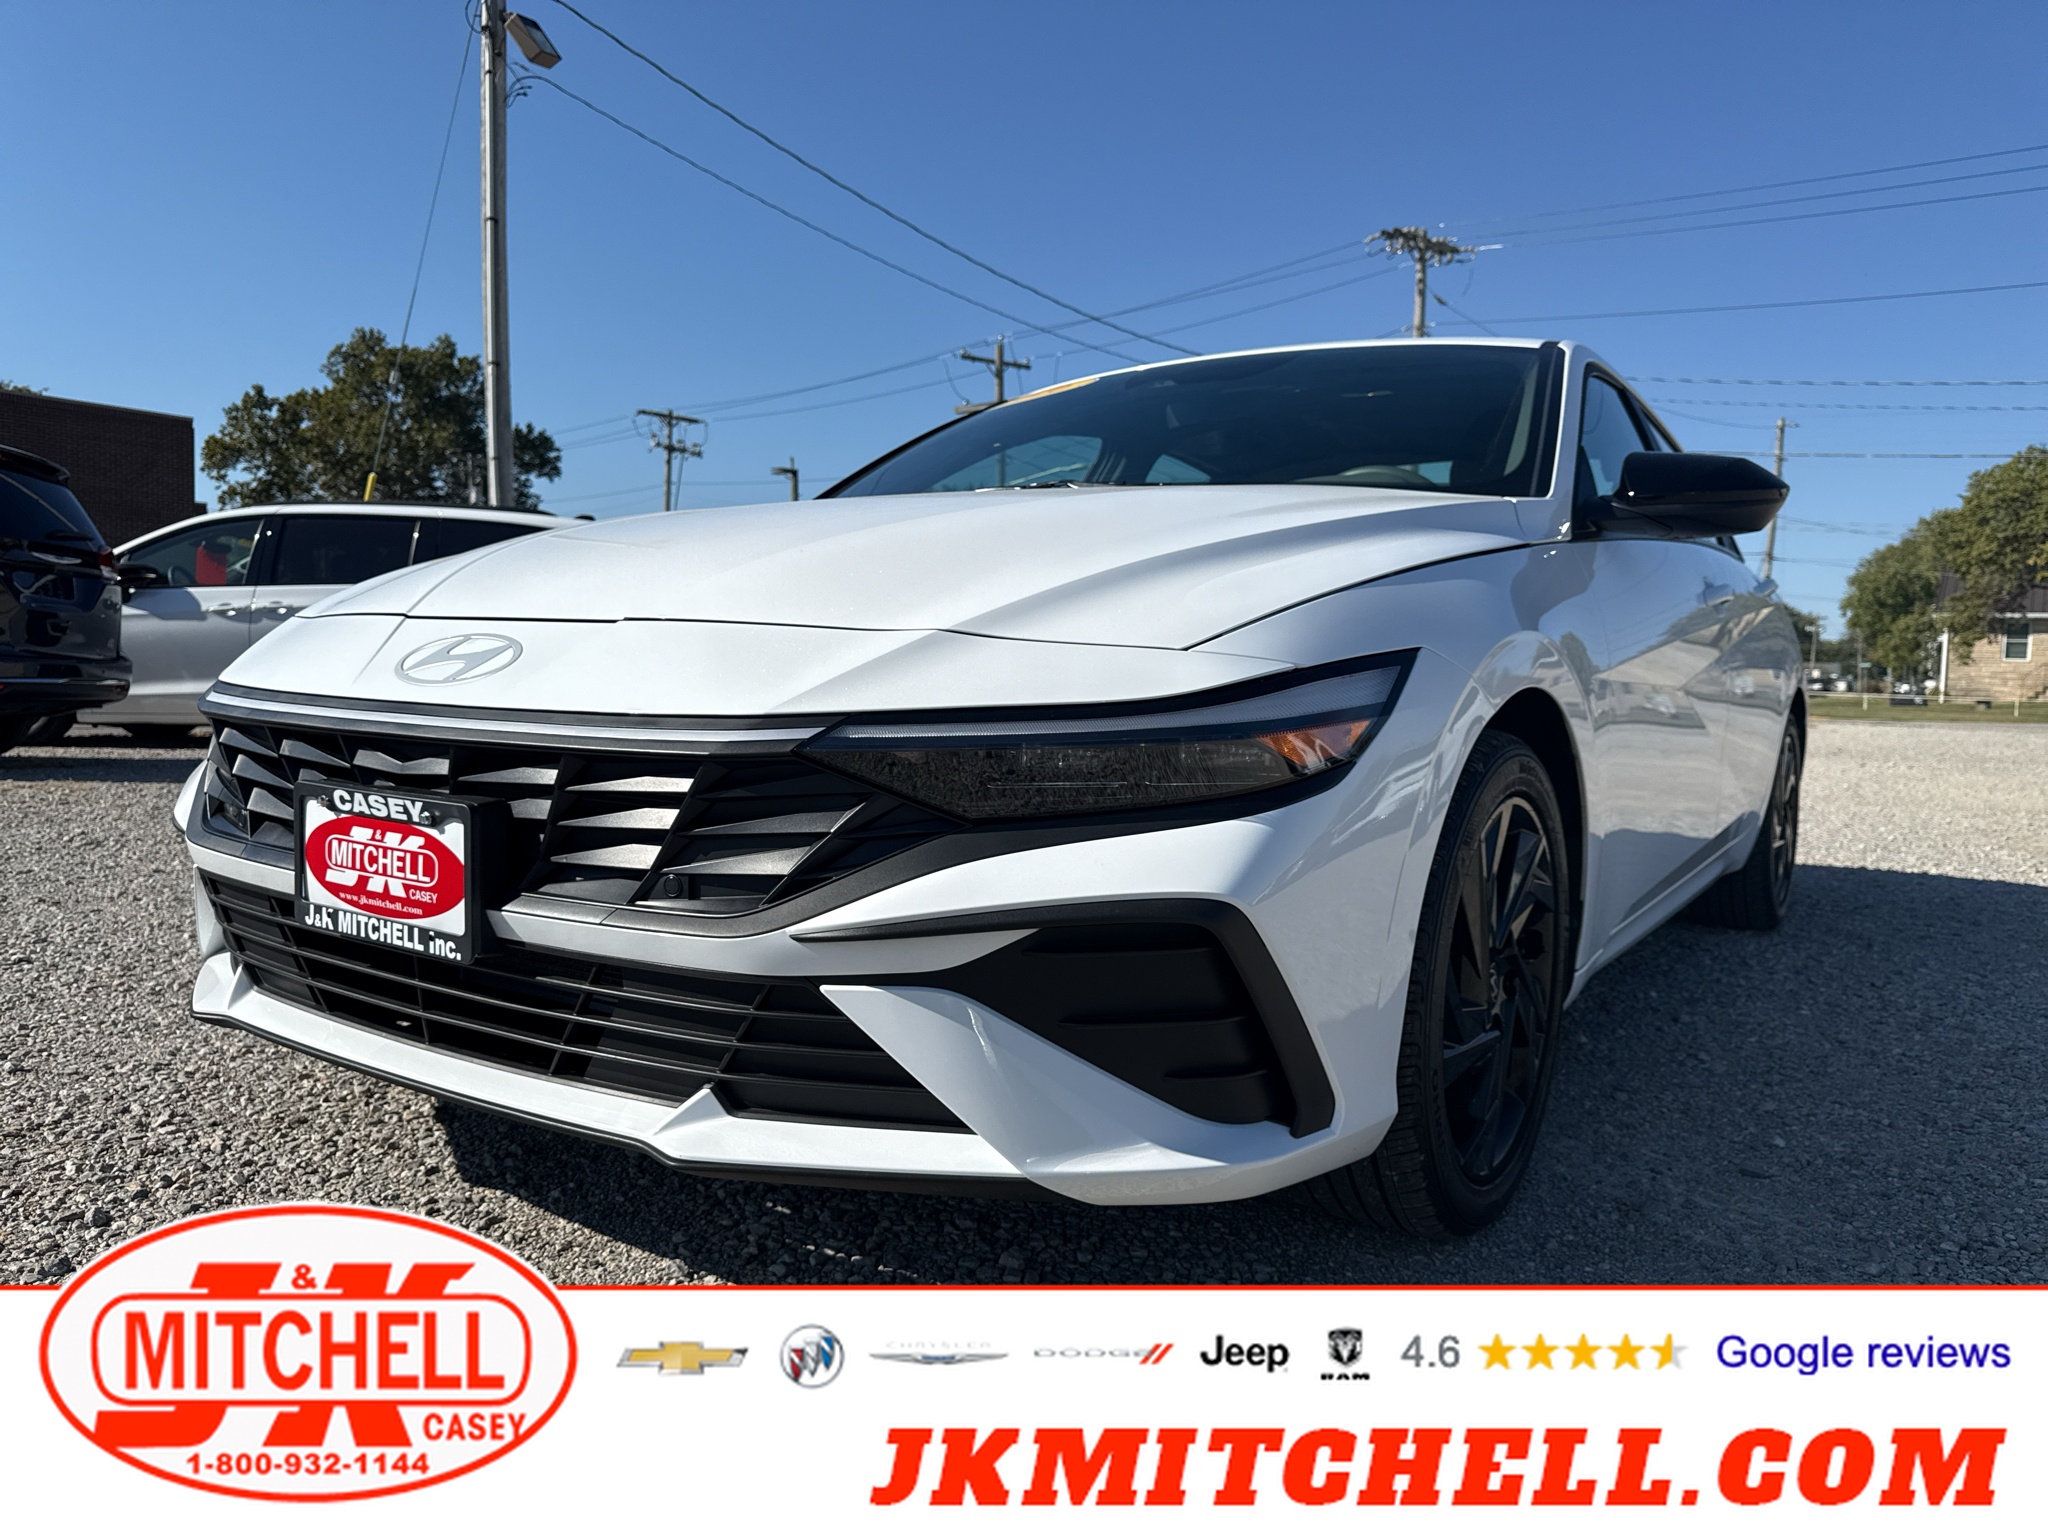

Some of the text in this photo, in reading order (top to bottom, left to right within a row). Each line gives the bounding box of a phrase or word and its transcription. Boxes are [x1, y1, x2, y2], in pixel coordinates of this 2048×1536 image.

[333, 789, 423, 823] CASEY
[331, 838, 431, 883] MITCHELL
[339, 892, 423, 915] www.jkmitchell.com
[409, 888, 438, 904] CASEY
[304, 904, 334, 930] J&K
[338, 910, 424, 952] MITCHELL
